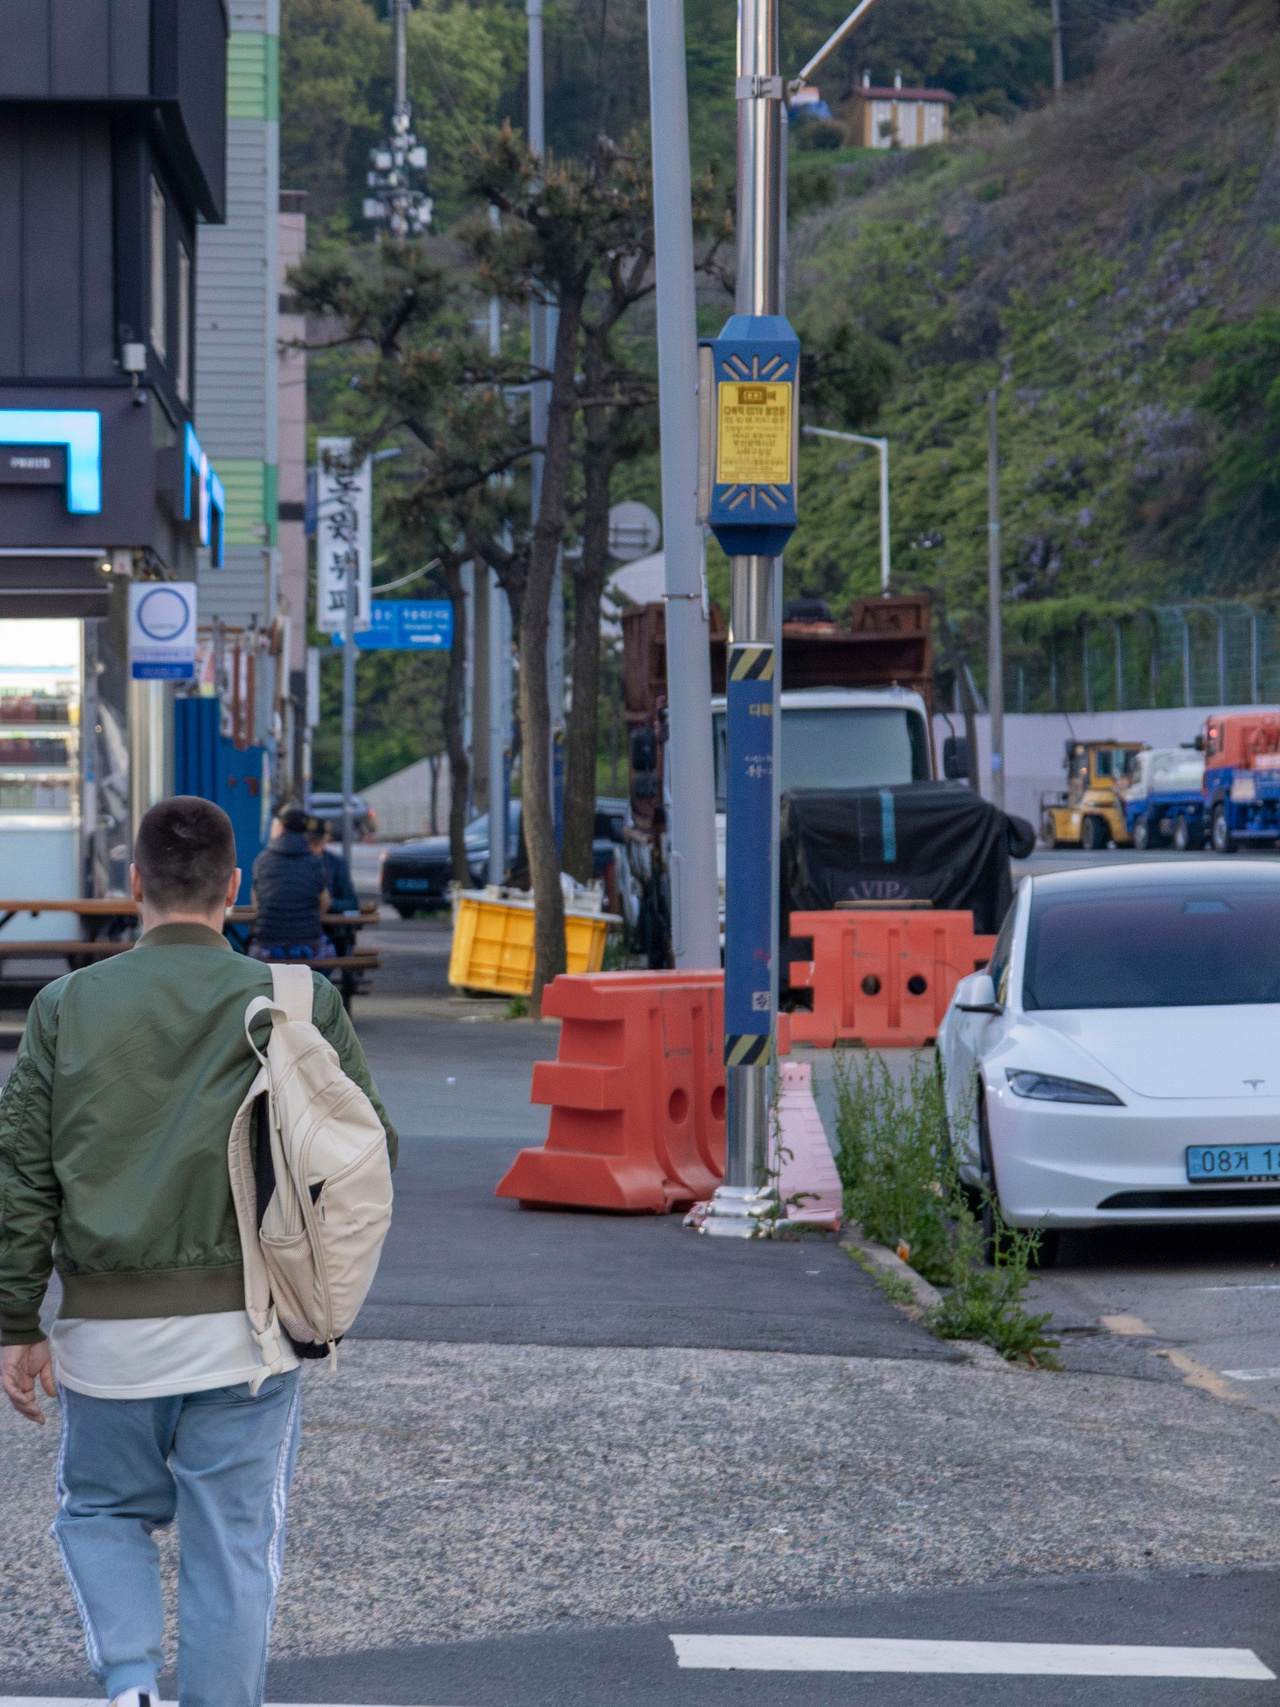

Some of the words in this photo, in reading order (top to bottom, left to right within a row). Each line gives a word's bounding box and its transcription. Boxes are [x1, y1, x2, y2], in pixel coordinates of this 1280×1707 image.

[860, 880, 900, 899] VIP
[1202, 1150, 1249, 1172] 08거
[1263, 1149, 1280, 1171] 1
